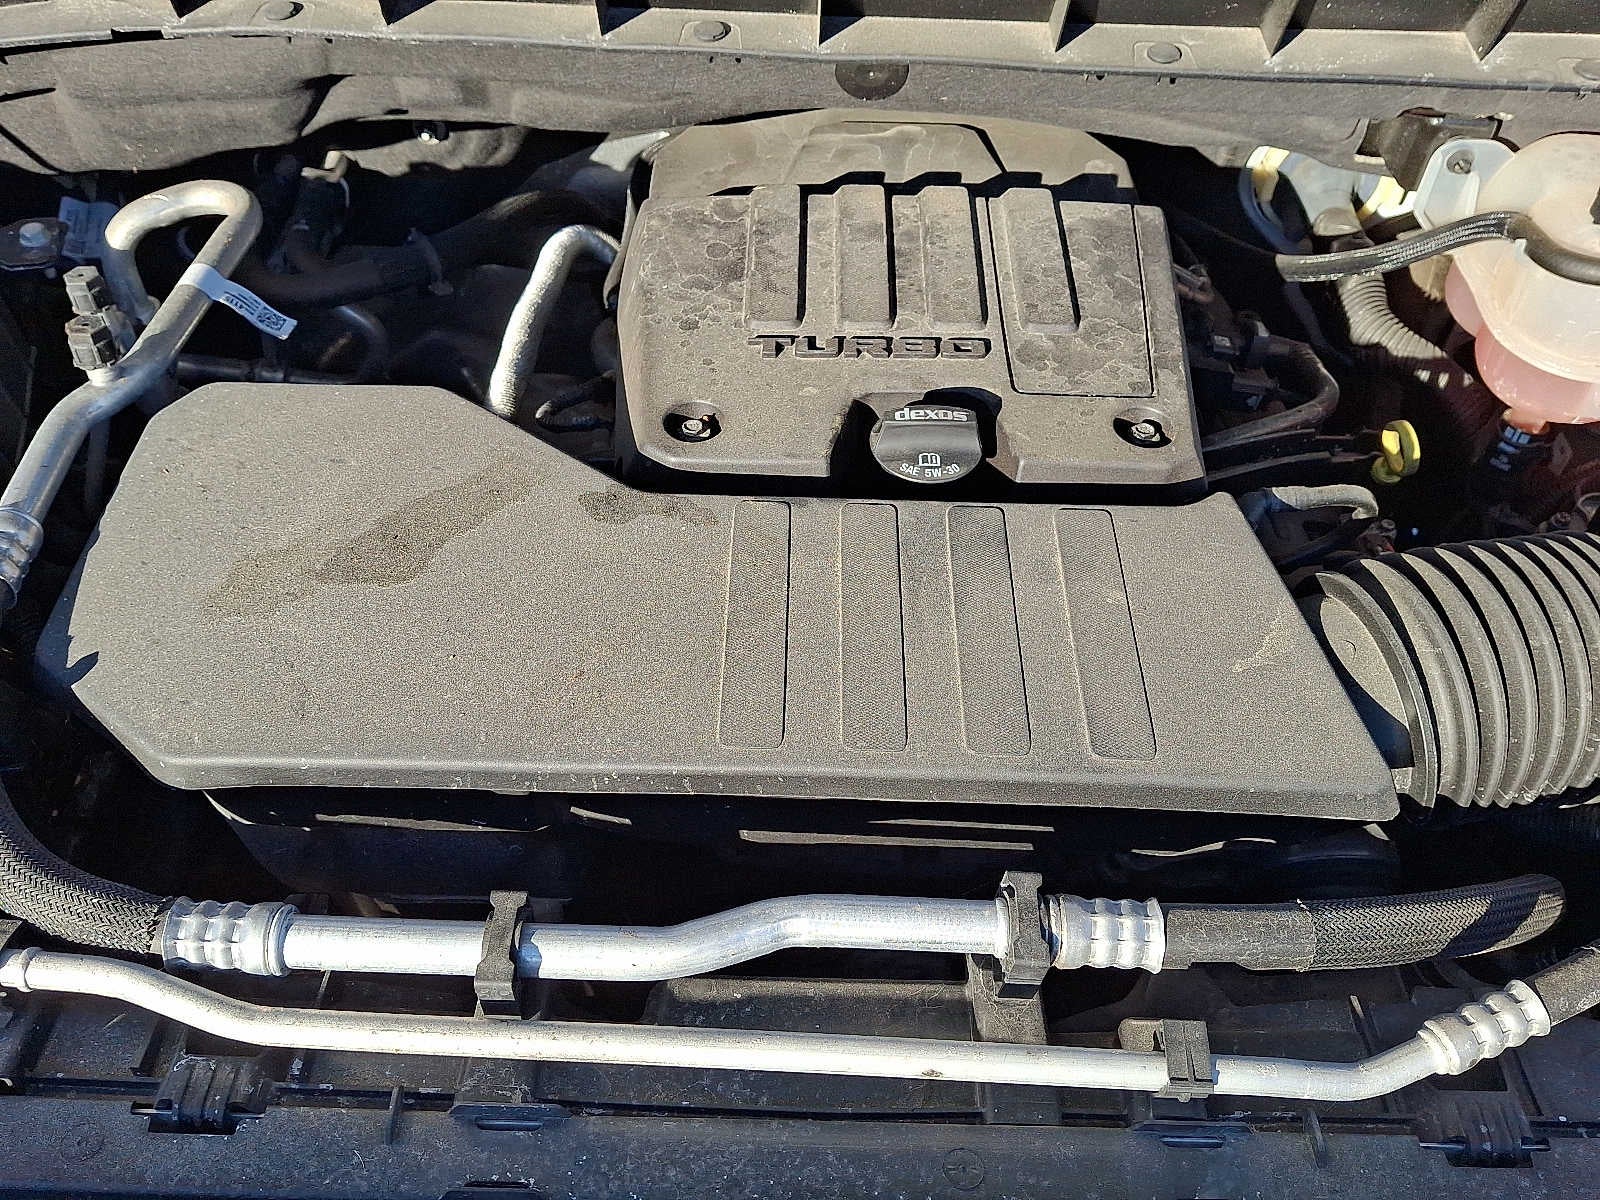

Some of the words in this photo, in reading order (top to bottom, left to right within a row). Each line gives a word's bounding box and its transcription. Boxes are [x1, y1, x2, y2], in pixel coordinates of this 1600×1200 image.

[748, 334, 992, 359] TURBO
[894, 407, 970, 422] dexos
[900, 463, 921, 477] SAE
[924, 463, 960, 478] 5W-30
